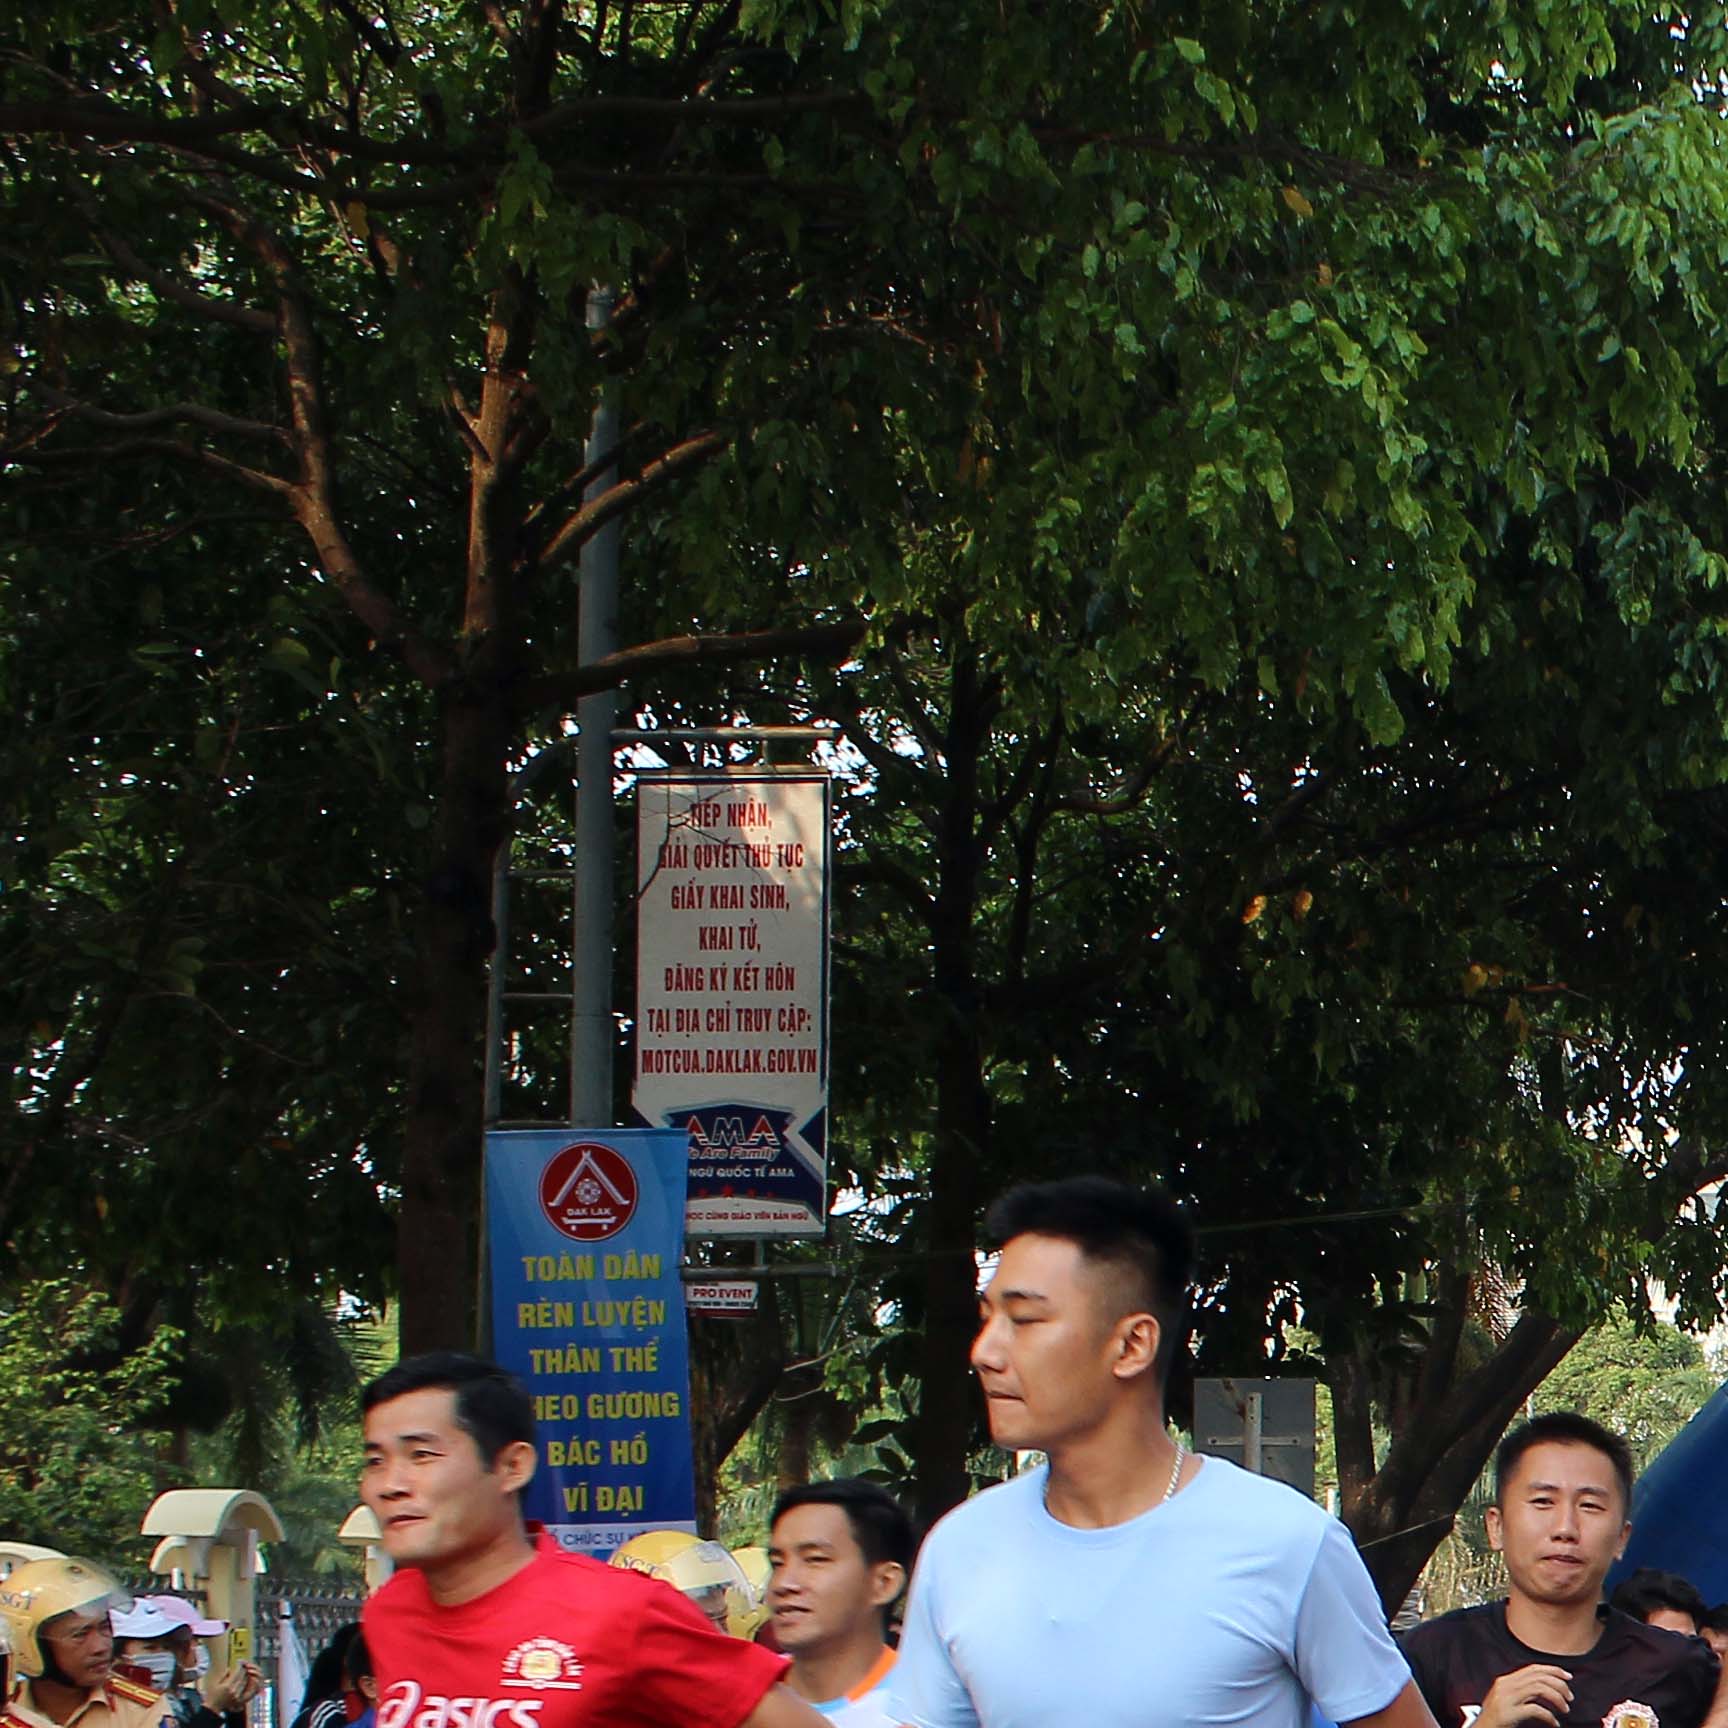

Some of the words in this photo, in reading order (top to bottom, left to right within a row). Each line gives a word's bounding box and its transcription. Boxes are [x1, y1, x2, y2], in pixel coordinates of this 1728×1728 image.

[777, 843, 804, 873] TỤC
[671, 877, 705, 910] GIẤY
[709, 885, 744, 910] KHAI
[750, 885, 790, 912] SINH,
[699, 926, 733, 950] KHAI
[664, 962, 704, 992] ĐĂNG
[709, 962, 728, 991] KÝ
[733, 960, 760, 991] KẾT
[765, 962, 795, 991] HÔN
[647, 1008, 670, 1038] TẠI
[676, 1008, 700, 1038] ĐỊA
[706, 1000, 730, 1032] CHỈ
[736, 1008, 772, 1032] TRUY
[777, 1002, 812, 1037] CẬP:
[642, 1049, 817, 1073] MOTCUA.DAKLAK.GOV.VN
[687, 1115, 781, 1146] AMA
[522, 1251, 595, 1282] TOÀN
[604, 1249, 662, 1280] DÂN
[517, 1297, 574, 1329] RÈN
[582, 1296, 665, 1331] LUYỆN
[529, 1343, 600, 1375] THÂN
[532, 1395, 579, 1421] HEO
[587, 1391, 681, 1419] GƯƠNG
[547, 1435, 601, 1467] BÁC
[563, 1482, 589, 1512] VĨ
[595, 1486, 644, 1517] ĐẠI
